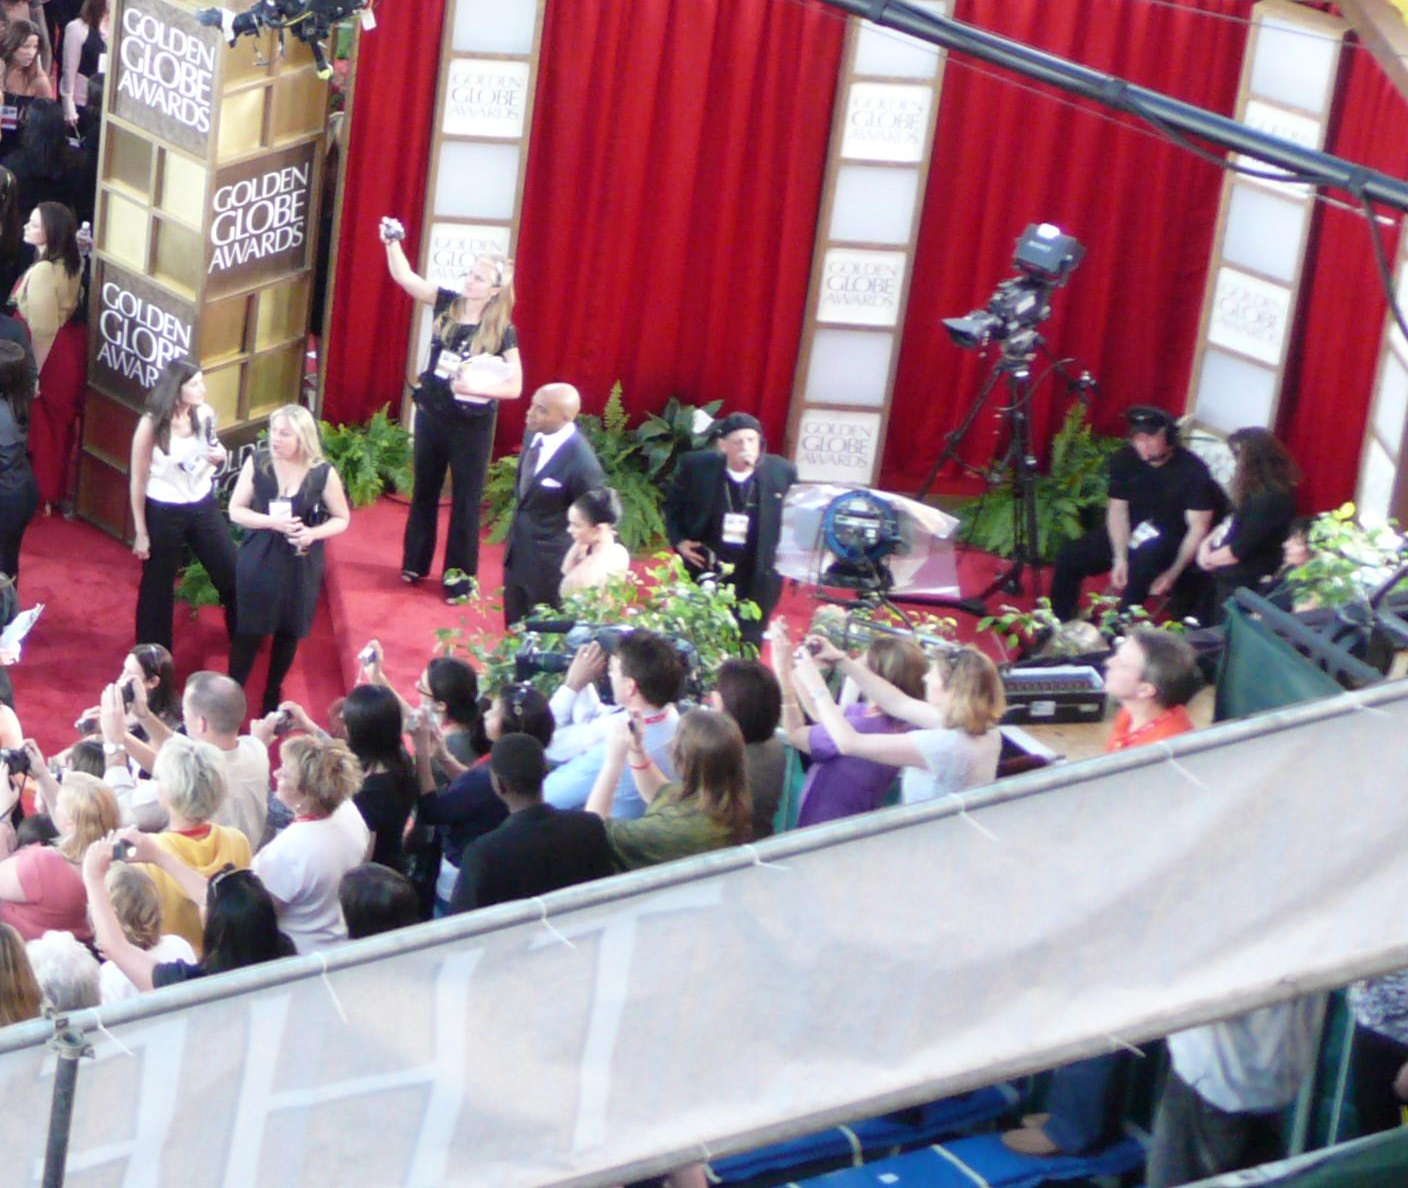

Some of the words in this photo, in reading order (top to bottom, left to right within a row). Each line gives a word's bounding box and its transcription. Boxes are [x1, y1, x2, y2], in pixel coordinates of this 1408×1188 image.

[122, 7, 215, 64] GOLDEN
[120, 34, 213, 107] GLOBE
[453, 72, 522, 88] GOLDEN
[118, 73, 210, 133] AWARDS
[451, 86, 517, 107] GLOBE
[851, 111, 921, 130] GLOBE
[213, 162, 310, 212] GOLDEN
[210, 188, 306, 246] GLOBE
[208, 219, 304, 274] AWARDS
[827, 260, 897, 277] GOLDEN
[826, 274, 896, 294] GLOBE
[825, 291, 893, 308] AWARDS
[101, 281, 191, 349] GOLDEN
[804, 422, 872, 438] GOLDEN
[801, 435, 871, 454] GLOBE
[799, 451, 869, 468] AWARDS
